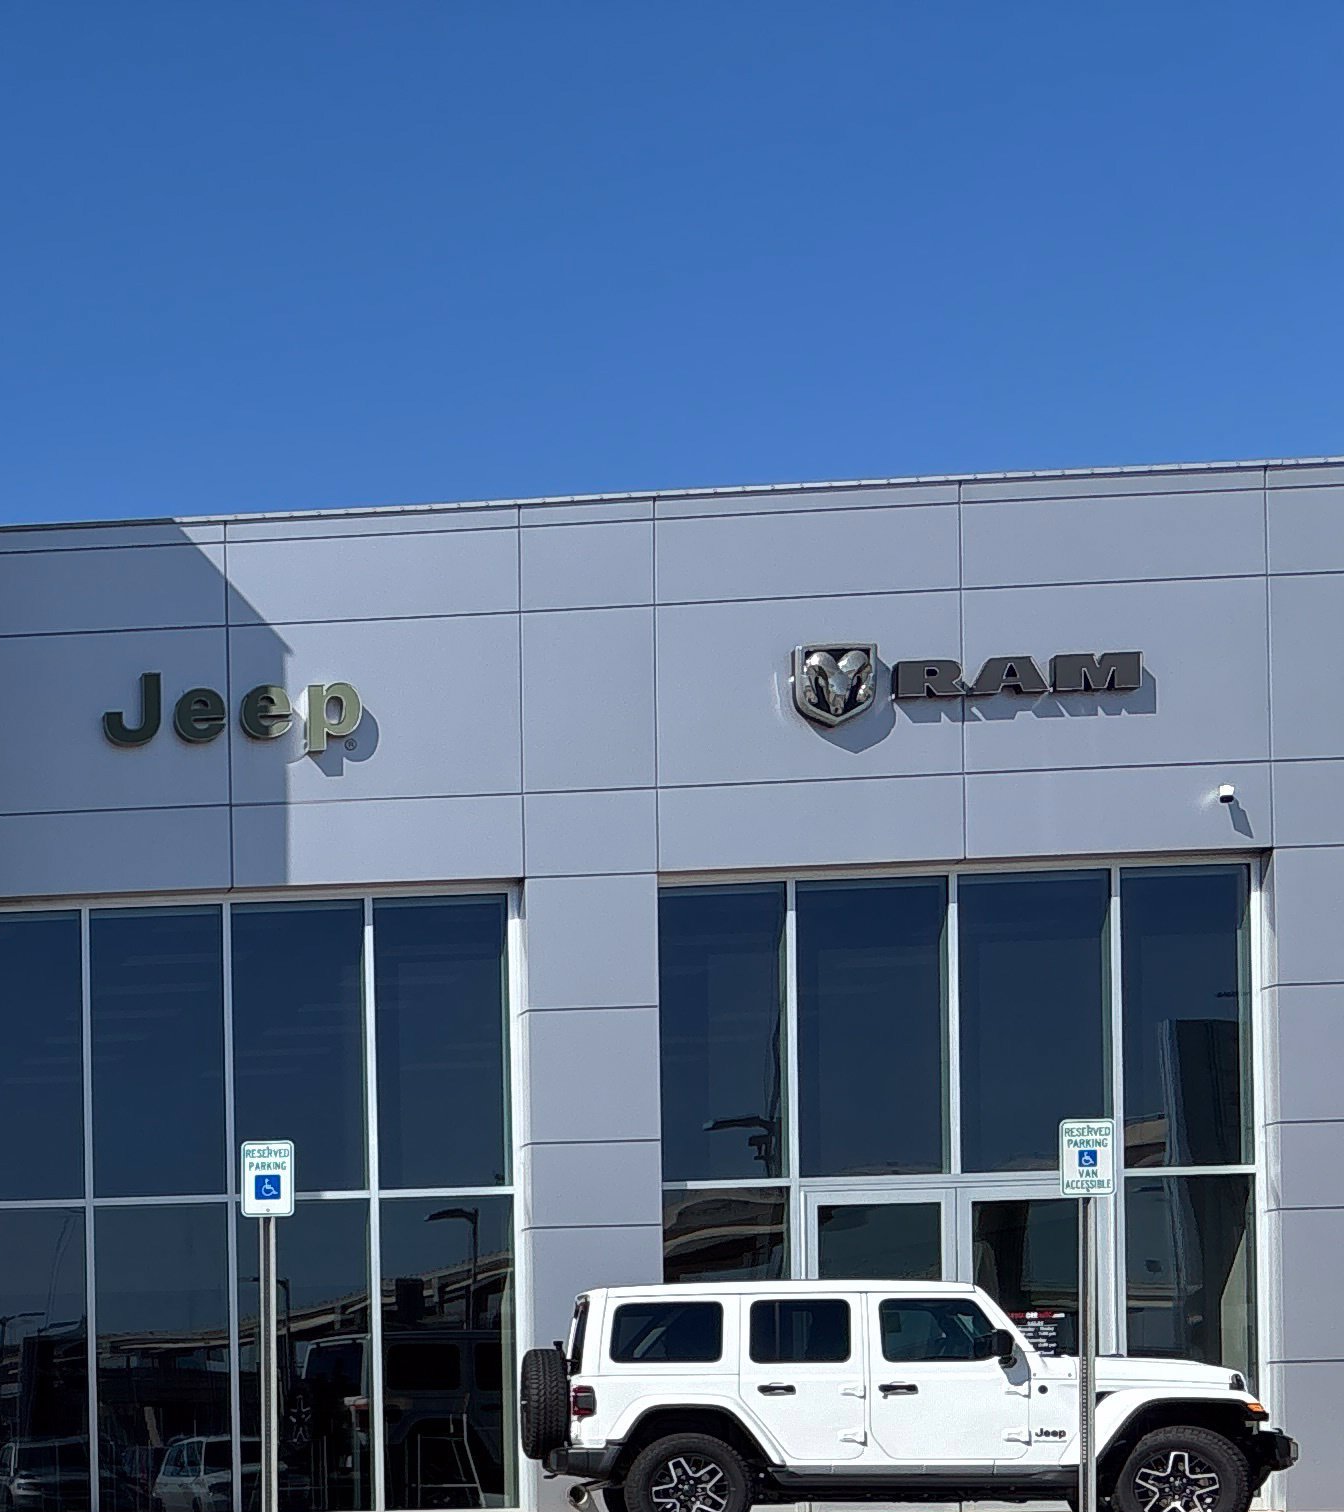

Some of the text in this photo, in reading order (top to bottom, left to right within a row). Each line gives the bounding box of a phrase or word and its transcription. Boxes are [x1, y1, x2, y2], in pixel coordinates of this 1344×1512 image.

[891, 651, 1144, 700] RAM
[103, 672, 363, 752] Jeep
[1064, 1127, 1111, 1138] RESERVED
[1067, 1138, 1109, 1149] PARKING
[245, 1148, 290, 1159] RESERVED
[248, 1161, 287, 1171] PARKING
[1077, 1168, 1099, 1178] VAN
[1064, 1179, 1111, 1190] ACCESSIBLE
[1034, 1427, 1067, 1439] Jeep
